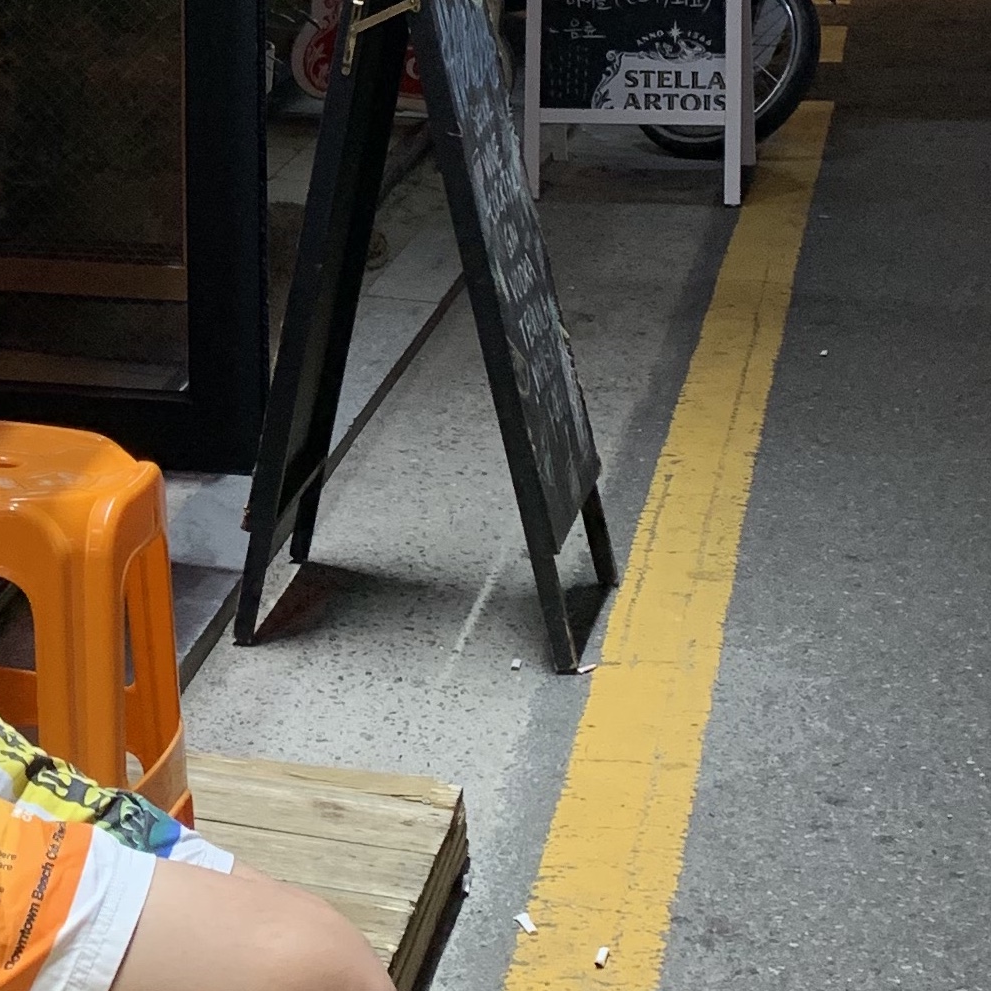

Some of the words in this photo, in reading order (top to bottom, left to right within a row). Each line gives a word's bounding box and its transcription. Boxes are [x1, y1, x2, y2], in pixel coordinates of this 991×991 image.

[636, 29, 665, 46] ANNO
[624, 69, 726, 90] STELLA
[623, 92, 726, 111] ARTOIS
[3, 901, 41, 971] Downtown
[31, 861, 56, 902] Beach
